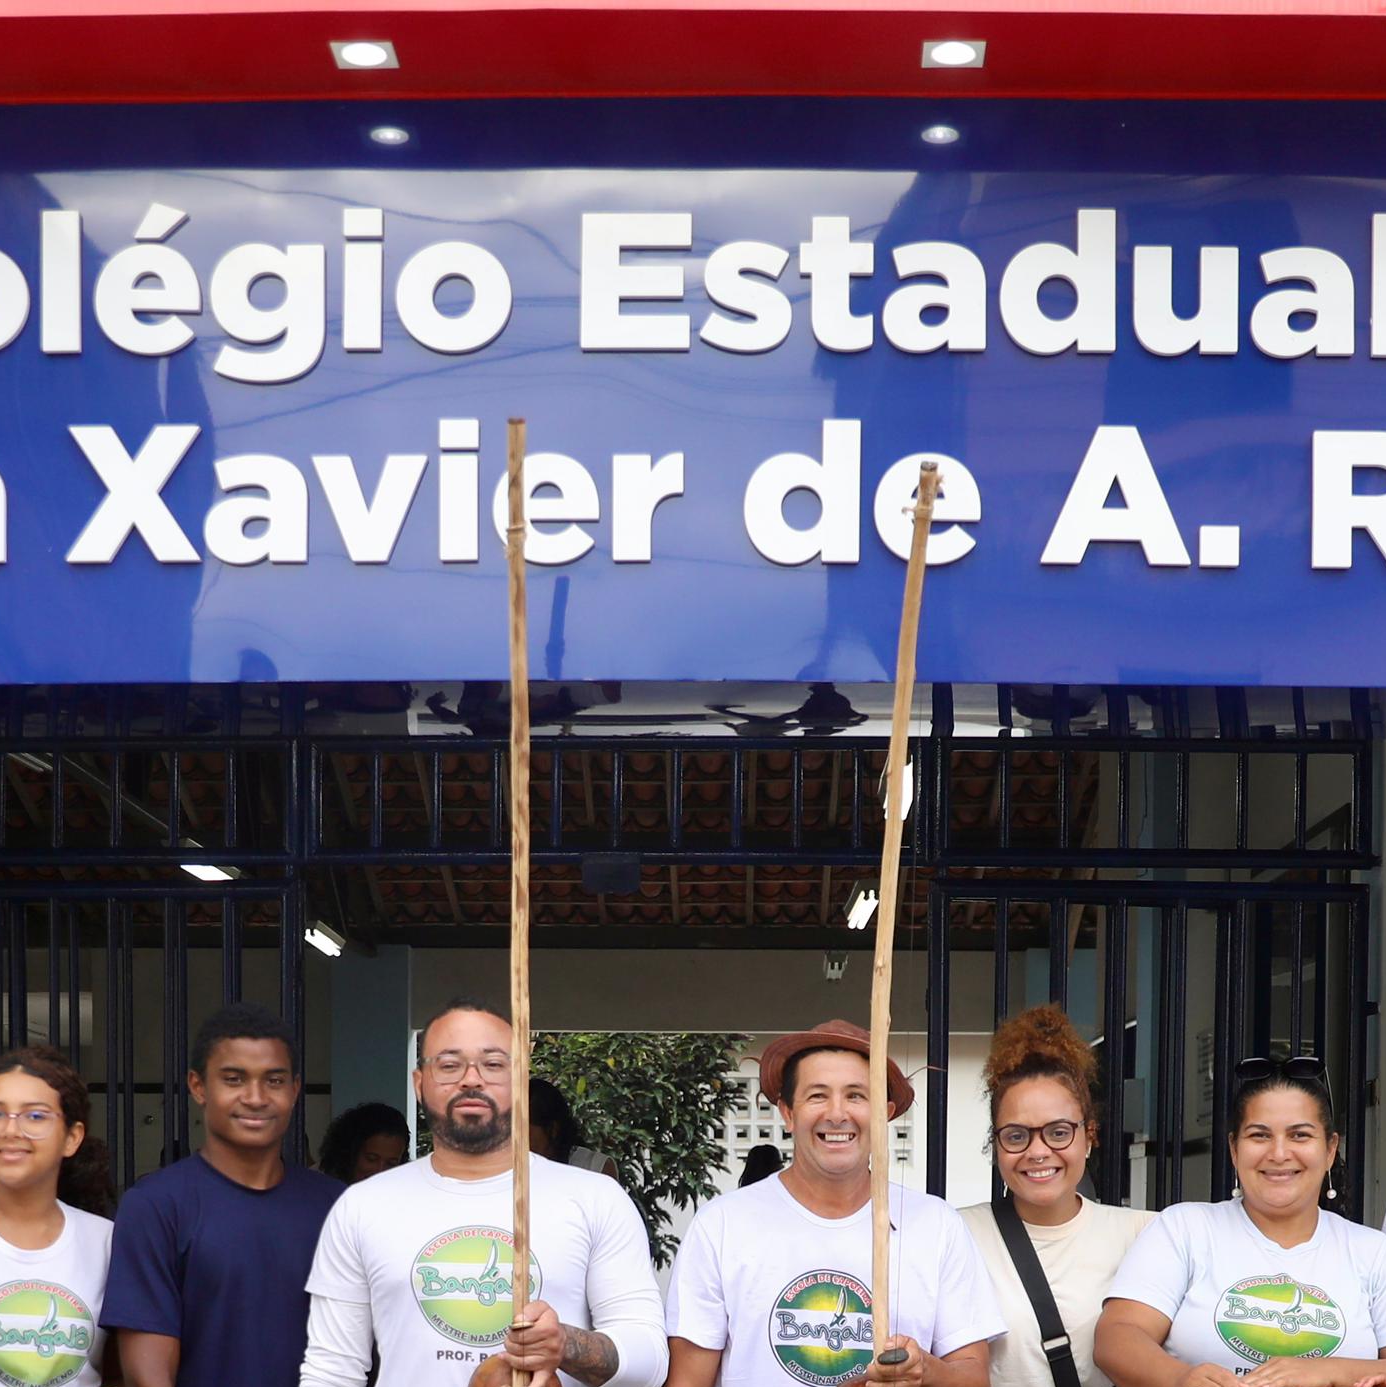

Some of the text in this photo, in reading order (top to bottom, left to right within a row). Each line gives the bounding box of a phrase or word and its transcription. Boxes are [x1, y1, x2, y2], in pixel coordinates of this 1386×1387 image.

[65, 417, 686, 566] Xavier
[743, 418, 983, 567] de
[1039, 425, 1242, 569] A.
[424, 1232, 461, 1257] ESCOLA
[463, 1229, 478, 1238] DE
[36, 1283, 86, 1314] CAPOEIRA
[784, 1273, 873, 1308] ESCOLA DE CAPOEIRA
[431, 1314, 469, 1340] MESTRE
[1224, 1295, 1341, 1335] Bangalô
[775, 1311, 873, 1352] Bangalô
[436, 1350, 475, 1362] PROF.
[1230, 1337, 1265, 1361] MESTRE
[788, 1360, 864, 1385] MESTRE NAZARENO
